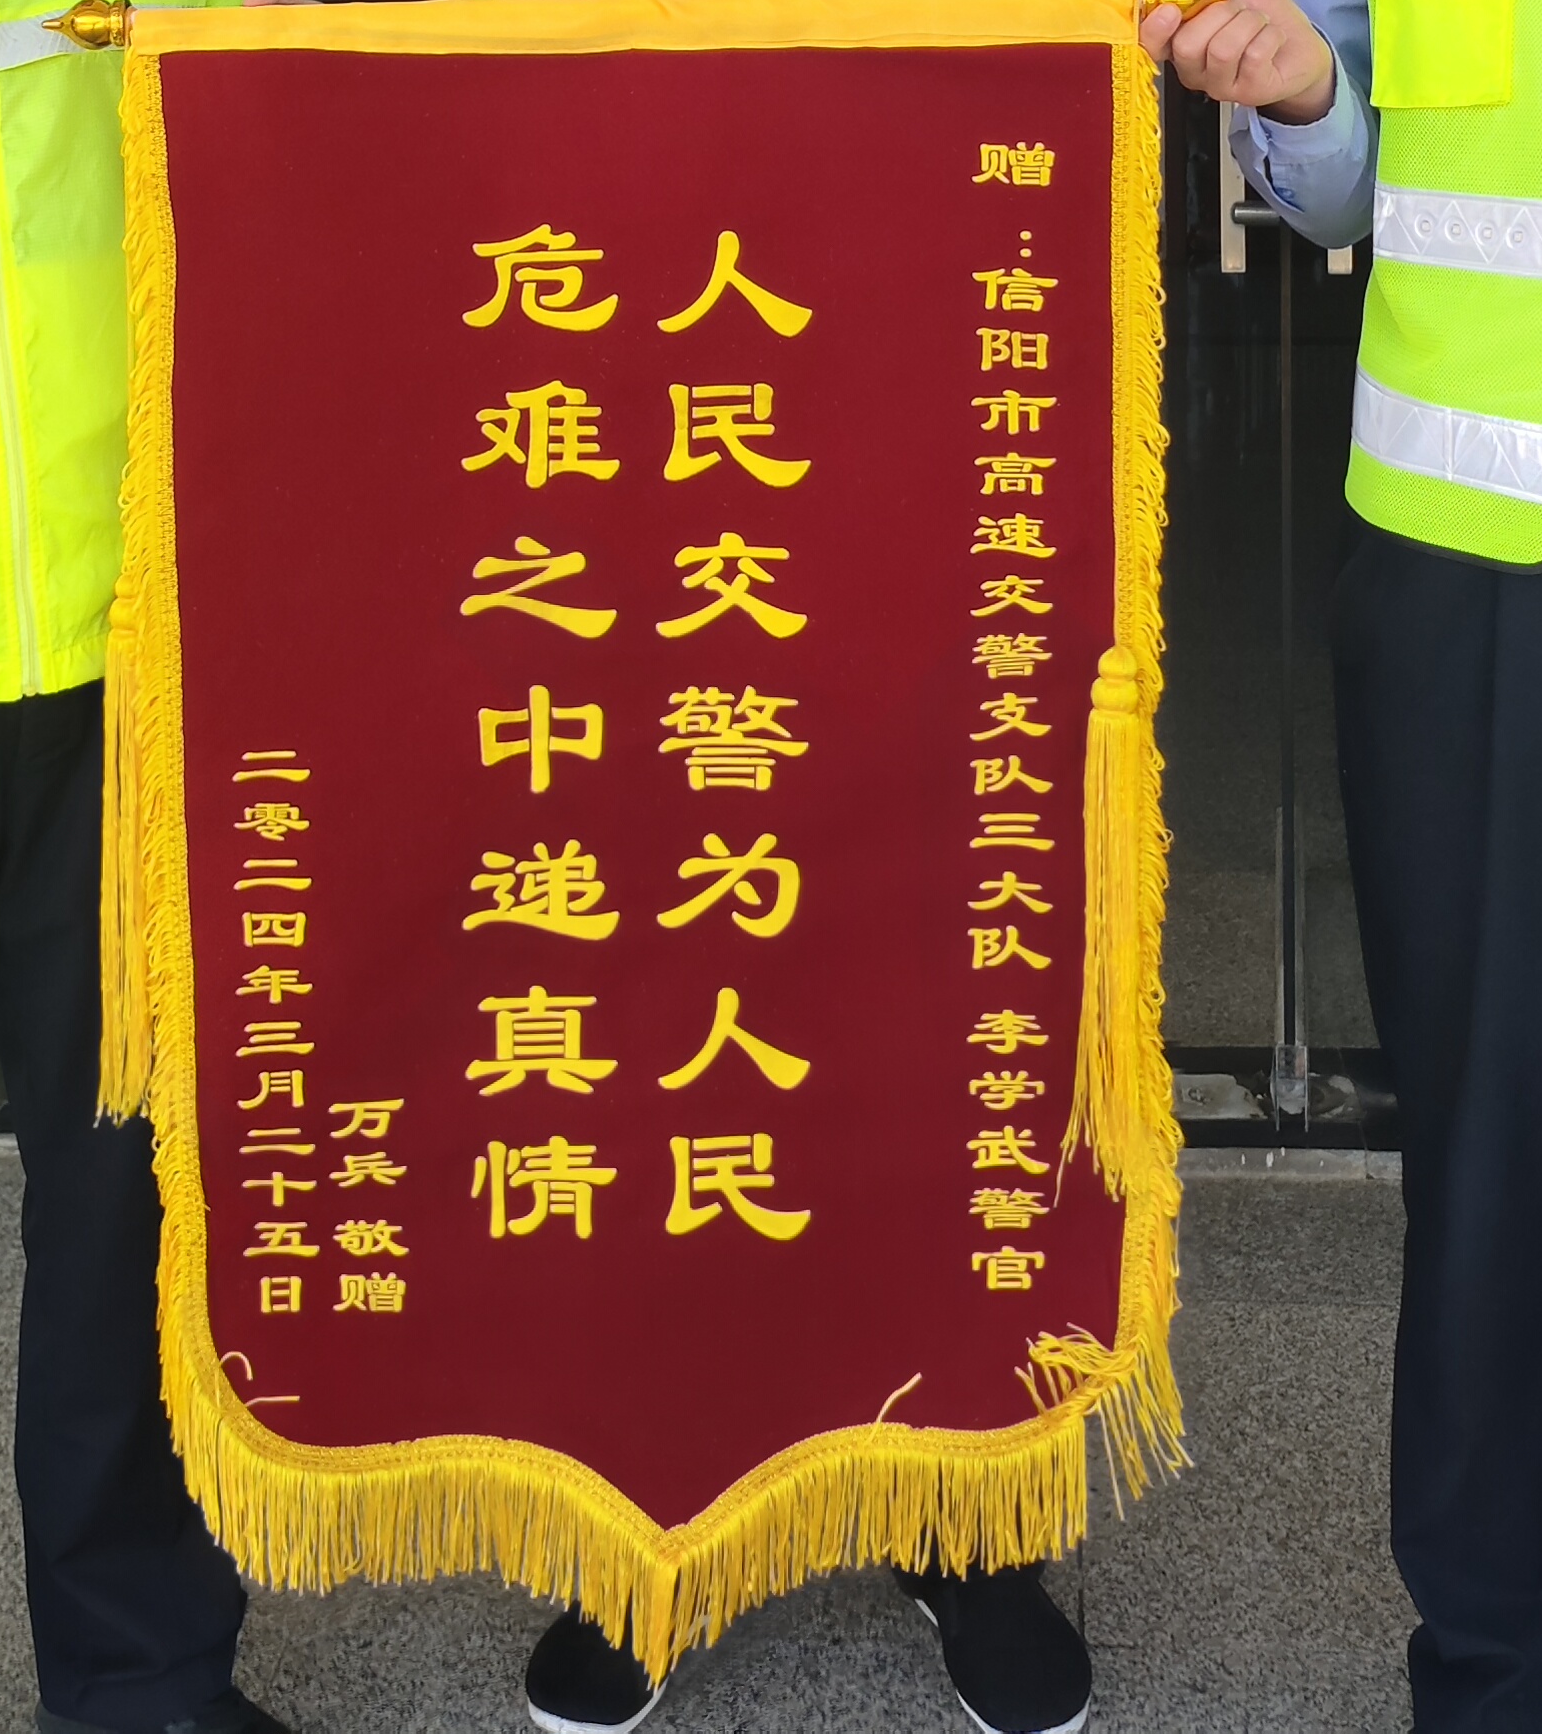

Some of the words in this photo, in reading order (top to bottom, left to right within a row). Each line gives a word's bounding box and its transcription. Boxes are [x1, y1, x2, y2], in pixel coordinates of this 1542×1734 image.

[233, 749, 321, 1314] 二零二四年三月二十五日
[460, 223, 621, 1240] 危难之中递真情
[656, 230, 813, 1241] 人民交警为人民
